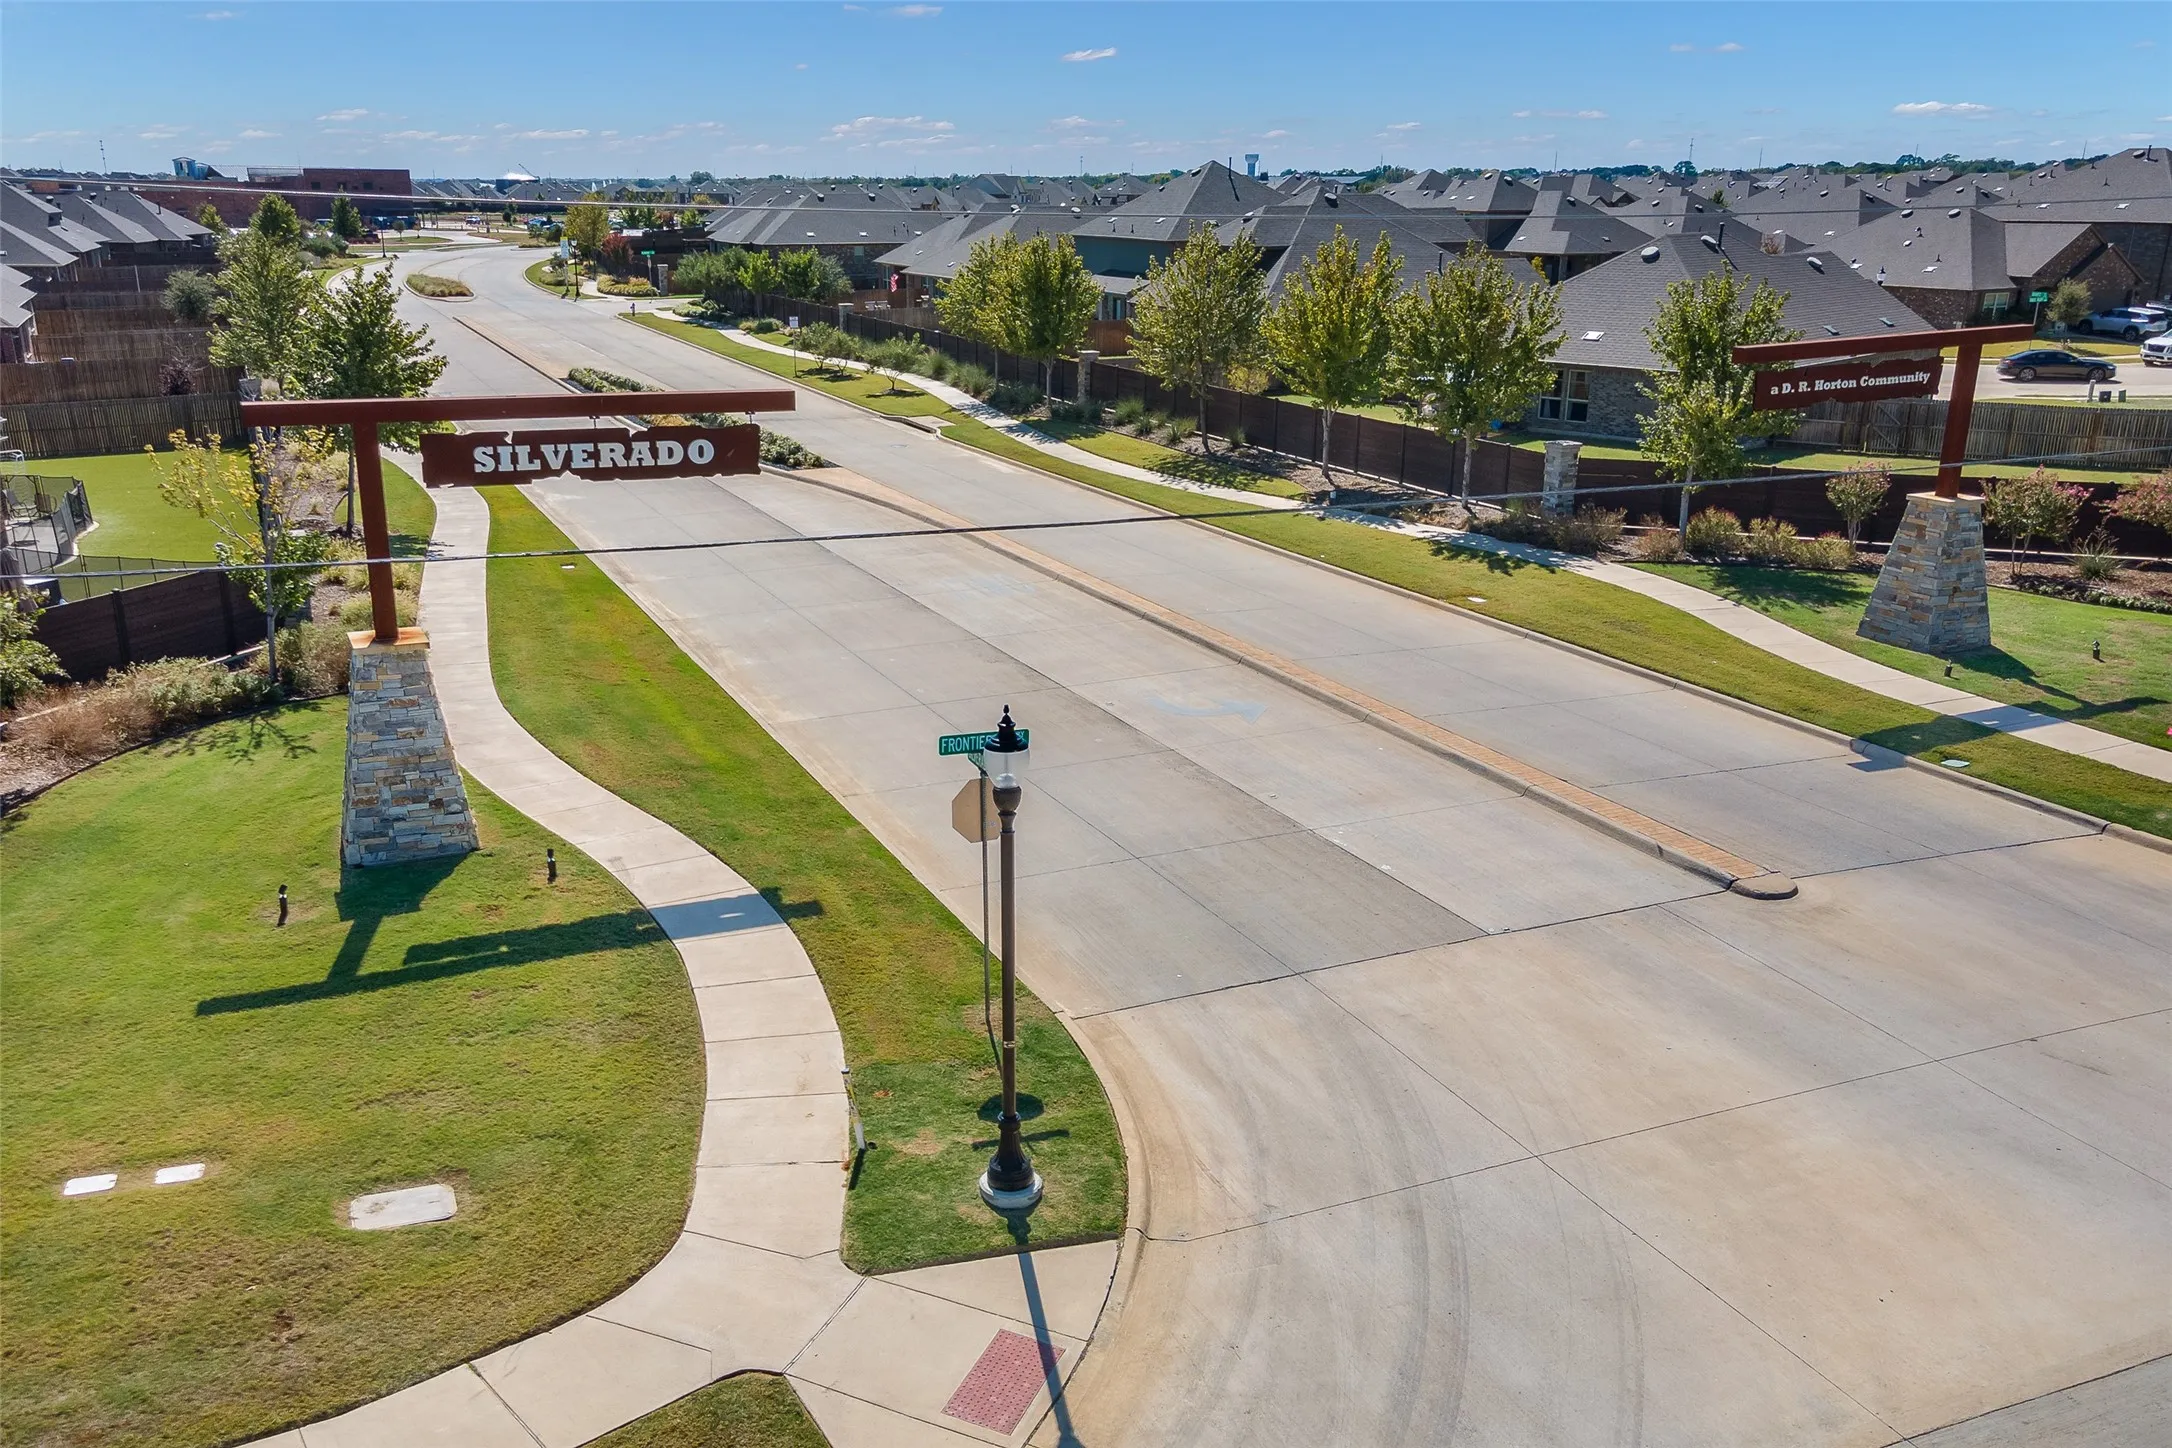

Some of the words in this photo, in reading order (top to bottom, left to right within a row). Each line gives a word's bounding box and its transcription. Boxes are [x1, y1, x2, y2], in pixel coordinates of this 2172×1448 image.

[1770, 386, 1779, 395] a
[1781, 383, 1795, 394] D.
[1798, 381, 1811, 393] R.
[1814, 377, 1857, 391] Horton
[1860, 371, 1931, 386] Community
[473, 439, 715, 473] SILVERADO
